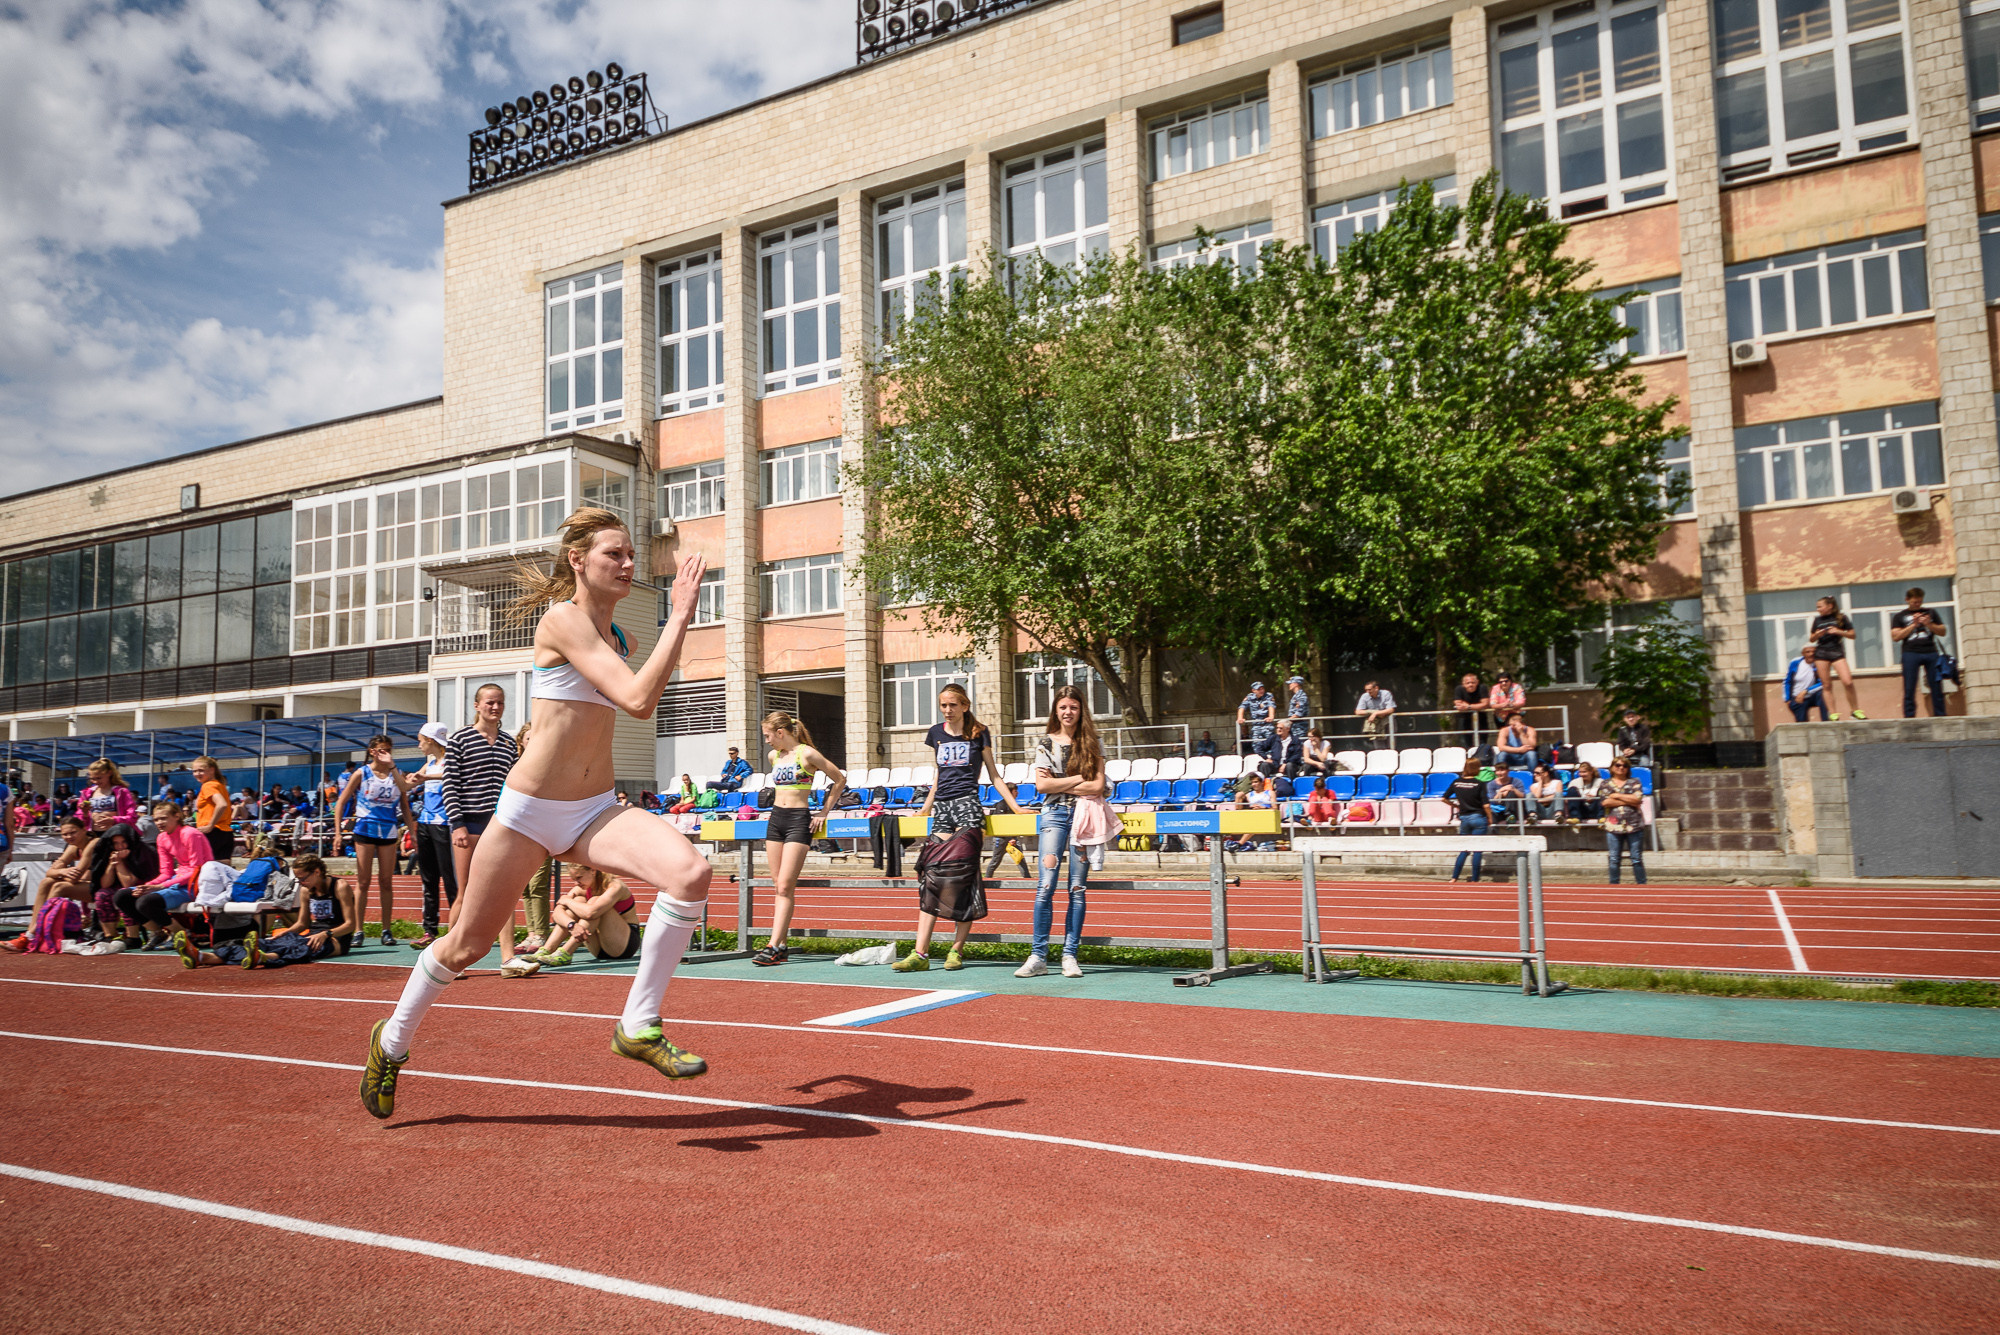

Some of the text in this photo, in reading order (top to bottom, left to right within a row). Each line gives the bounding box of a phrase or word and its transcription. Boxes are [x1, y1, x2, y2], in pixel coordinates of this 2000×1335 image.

[944, 745, 967, 760] 312
[776, 766, 794, 781] 286
[378, 786, 393, 799] 23
